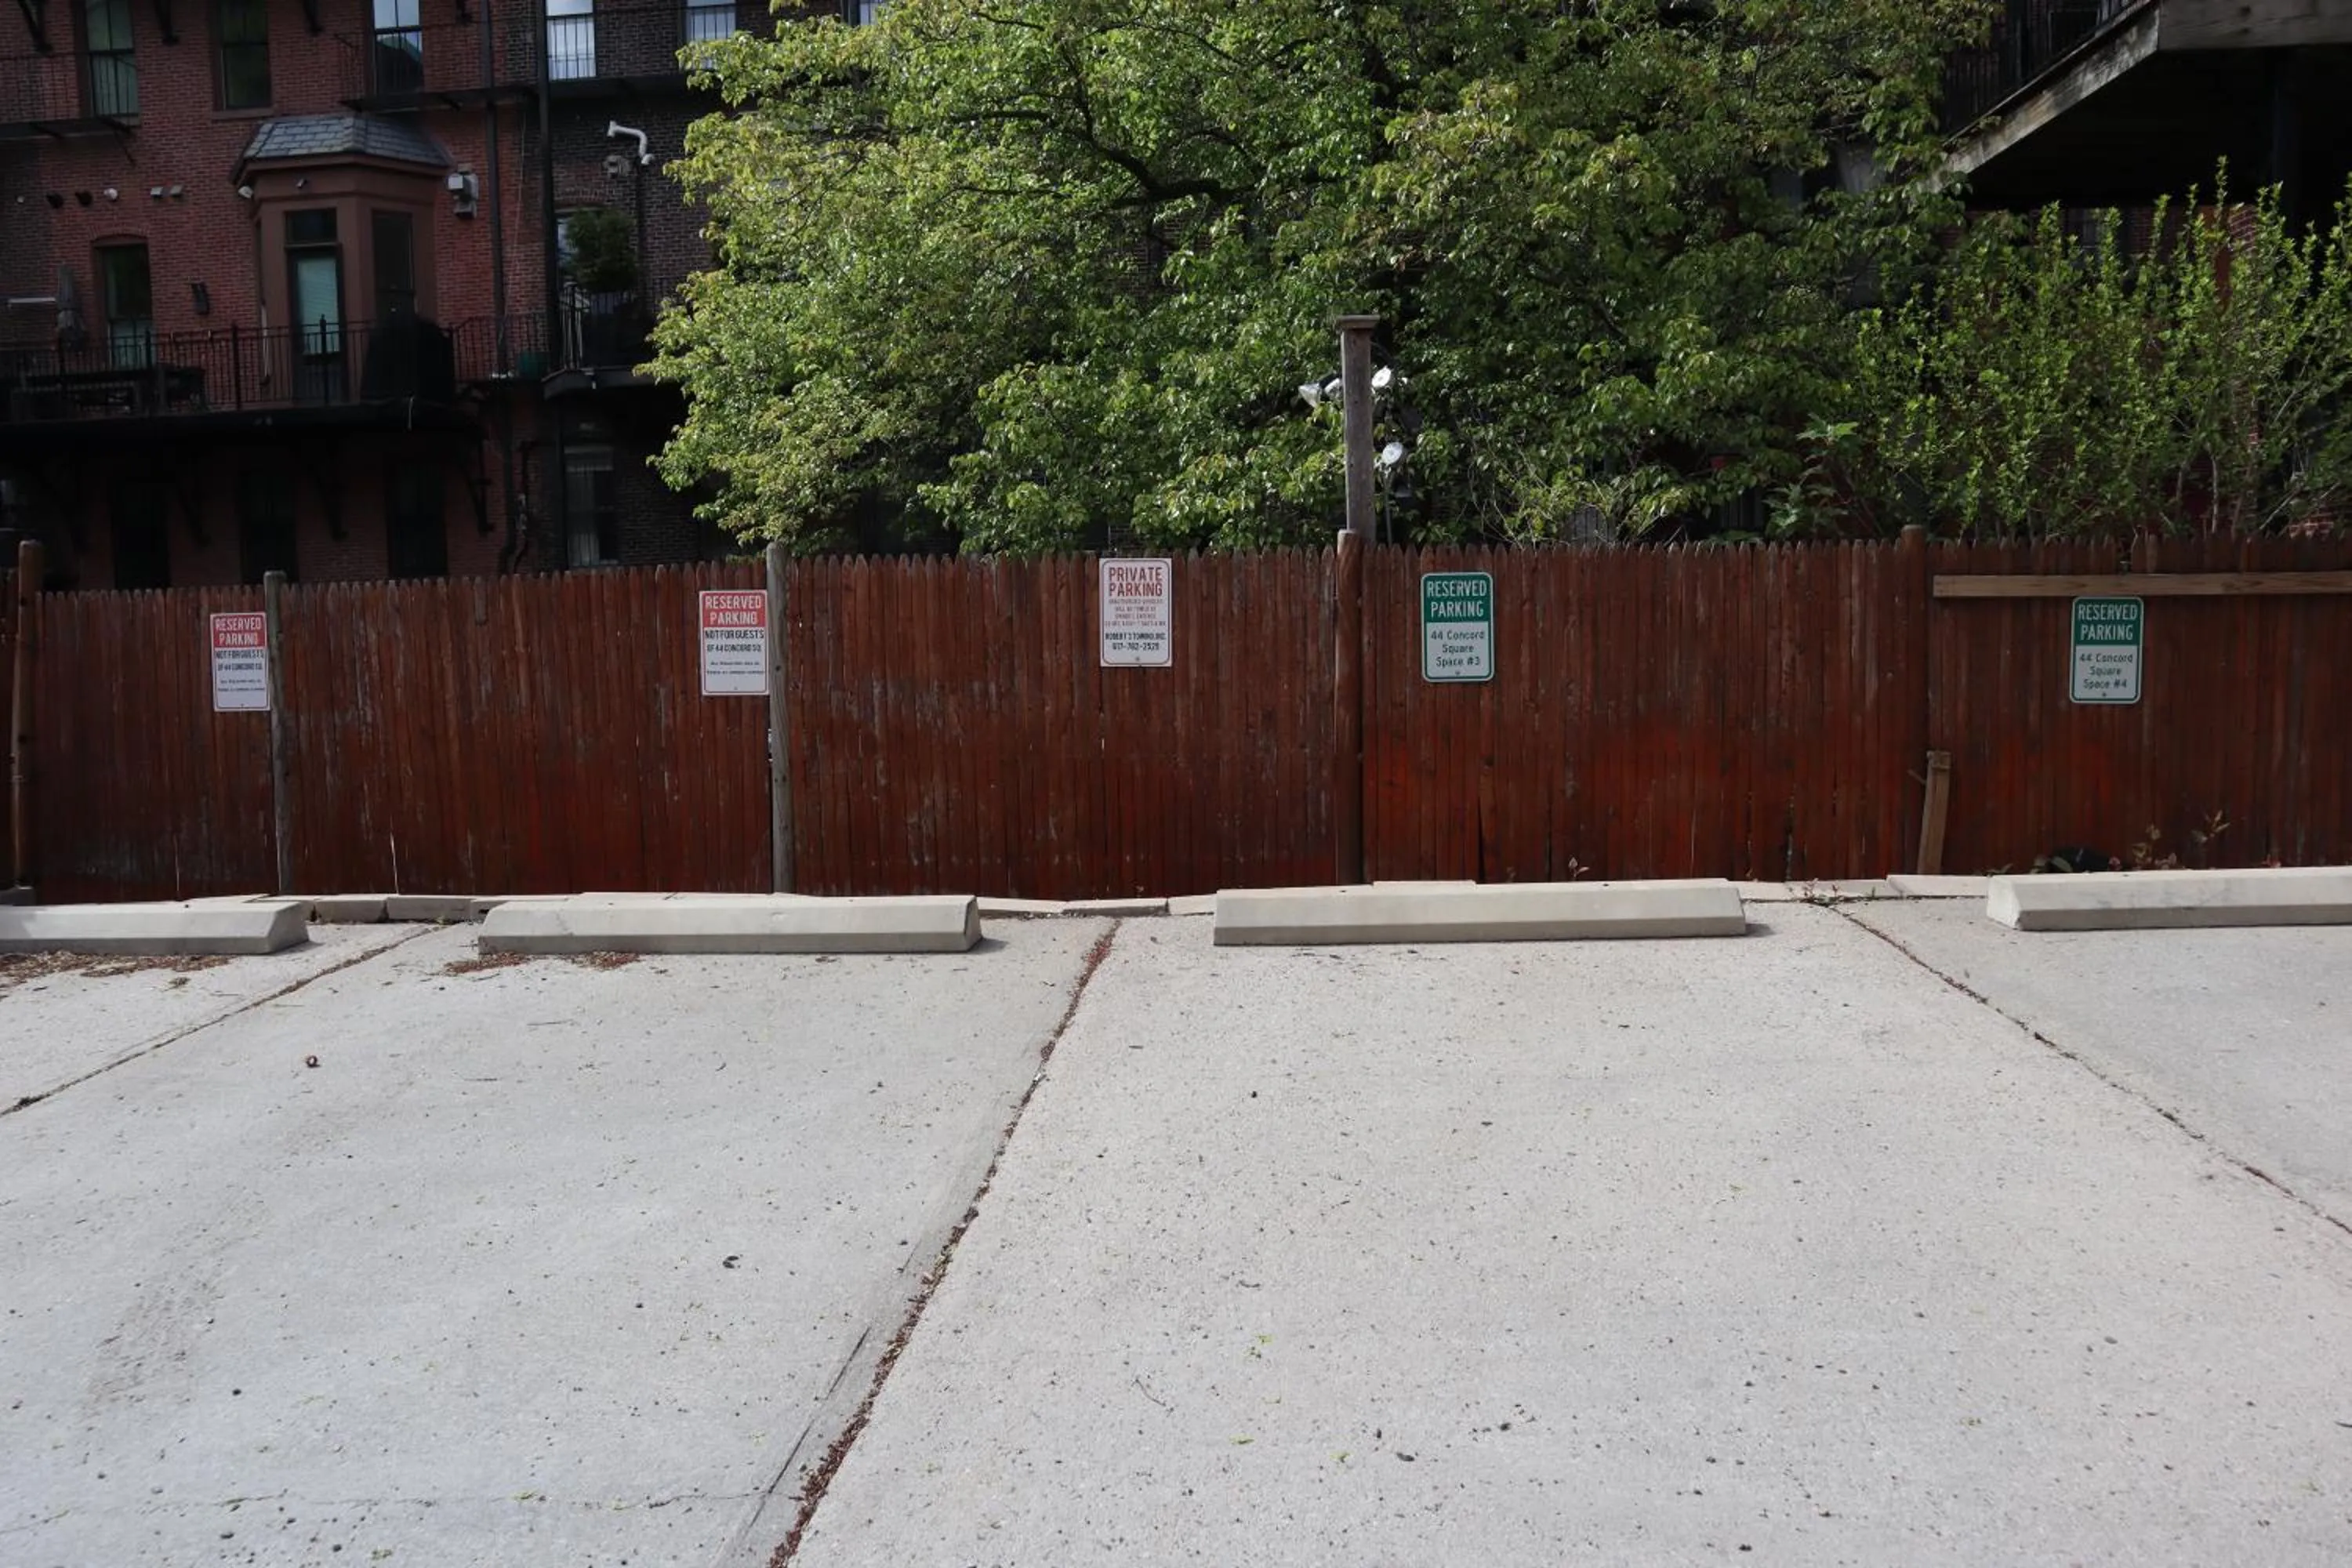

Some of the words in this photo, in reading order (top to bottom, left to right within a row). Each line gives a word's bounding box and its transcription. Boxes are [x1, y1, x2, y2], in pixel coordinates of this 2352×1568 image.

[1109, 567, 1163, 582] PRIVATE
[1109, 583, 1163, 597] PARKING
[1427, 580, 1487, 597] RESERVED
[704, 595, 762, 609] RESERVED
[1431, 601, 1484, 618] PARKING
[2078, 604, 2138, 621] RESERVED
[215, 617, 262, 631] RESERVED
[710, 612, 758, 625] PARKING
[219, 632, 258, 646] PARKING
[1431, 630, 1443, 641] 44
[1446, 630, 1485, 641] Concord
[2080, 624, 2133, 641] PARKING
[1442, 644, 1475, 655] Square
[1436, 656, 1464, 668] Space
[1467, 656, 1480, 666] #3
[2080, 653, 2092, 662] 44
[2096, 653, 2133, 663] Concord
[2089, 666, 2122, 677] Square
[2083, 678, 2110, 690] Space
[2114, 678, 2128, 688] #4
